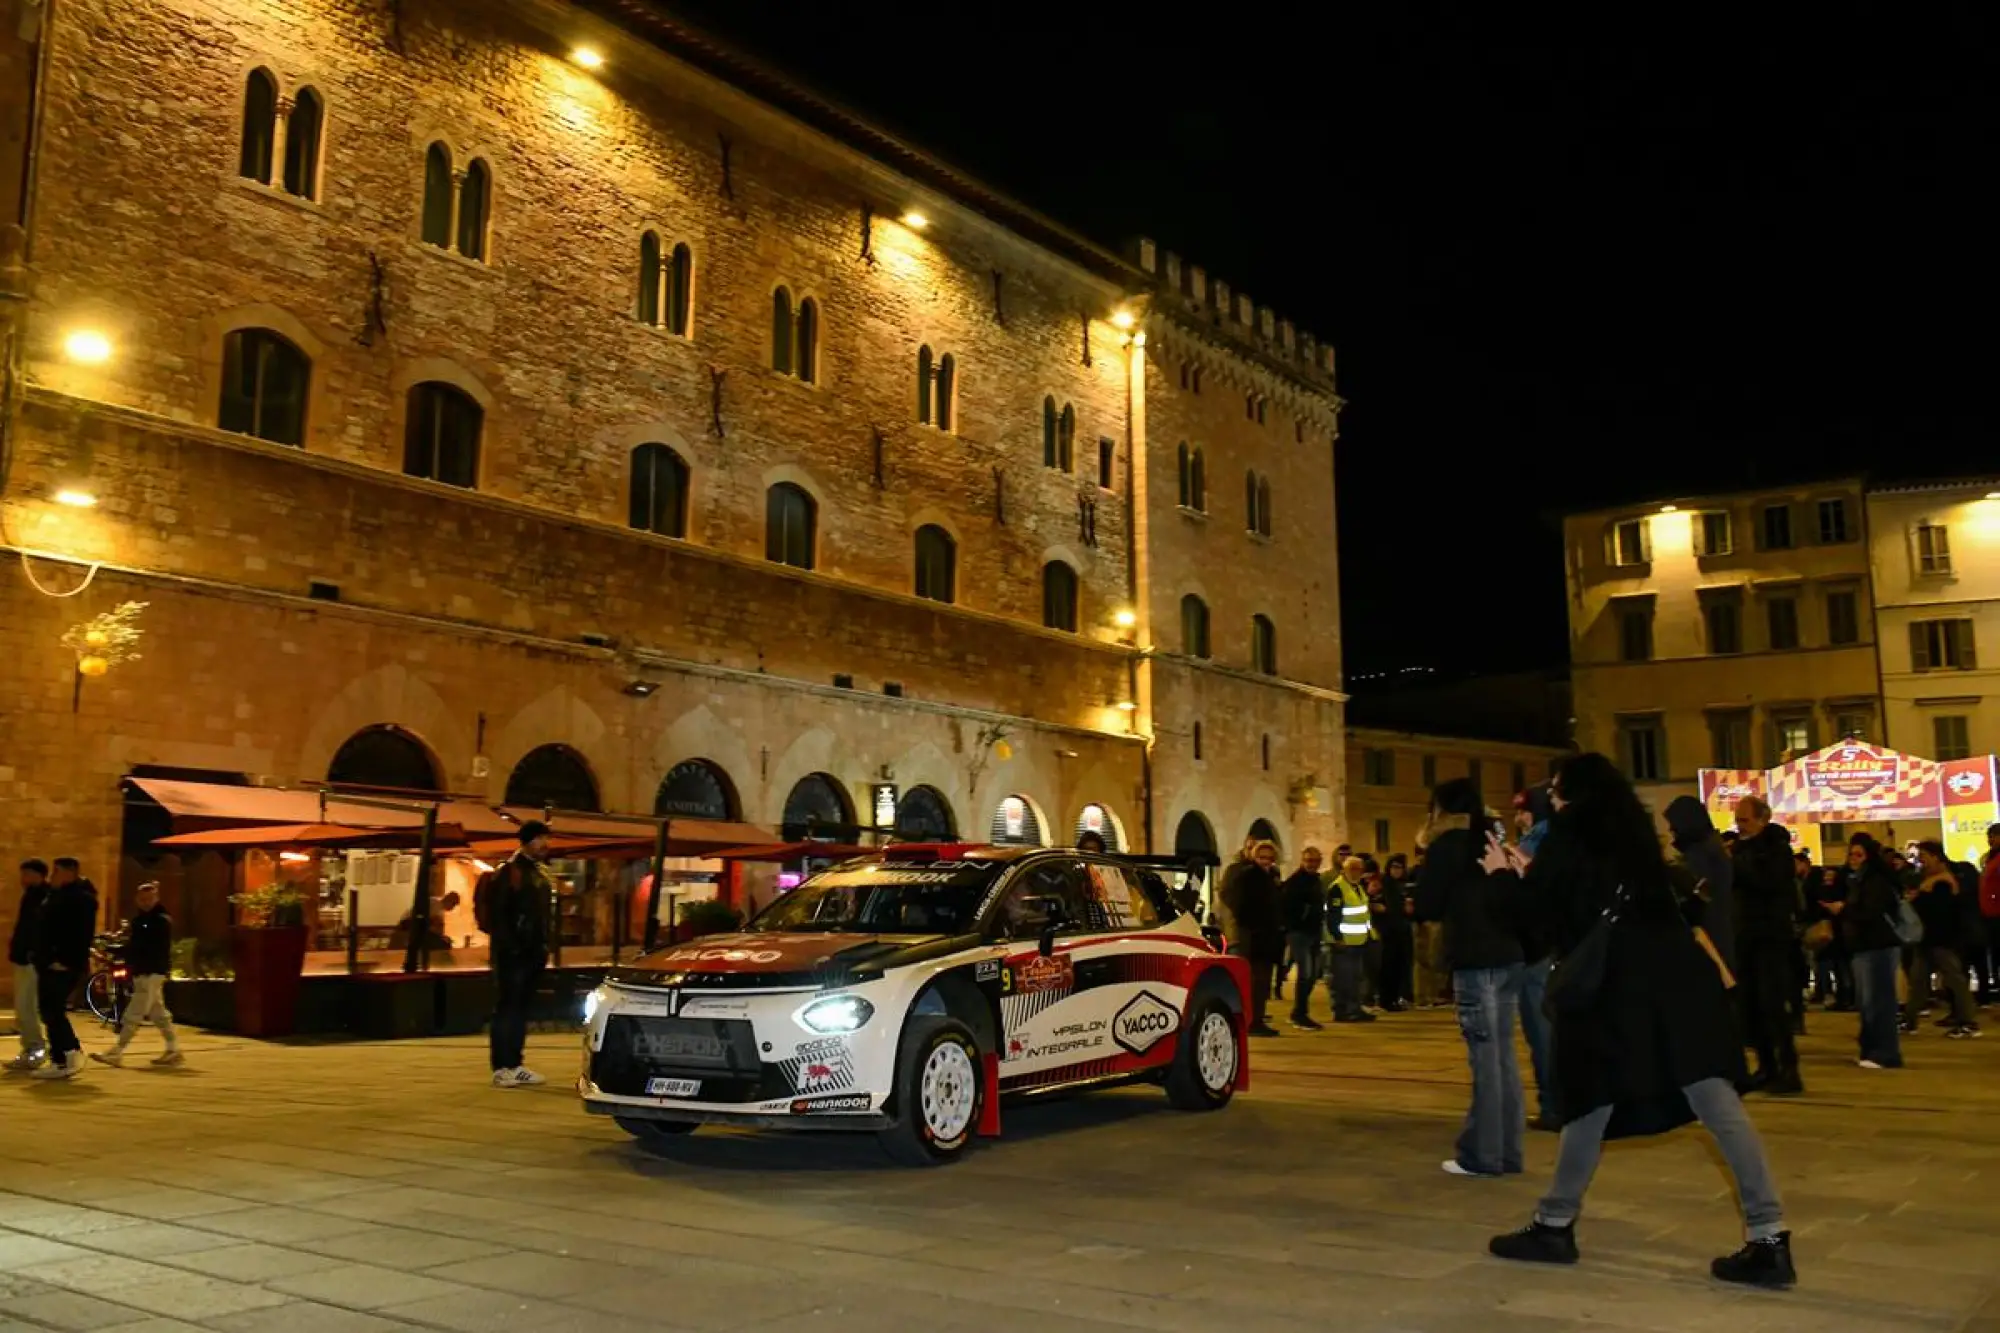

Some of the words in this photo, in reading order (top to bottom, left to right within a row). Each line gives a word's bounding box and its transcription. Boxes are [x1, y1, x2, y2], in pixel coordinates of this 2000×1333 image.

[1001, 968, 1011, 991] 9
[1053, 1018, 1107, 1036] YPSILON
[1122, 1012, 1169, 1035] YACCO
[1027, 1035, 1104, 1058] INTEGRALE
